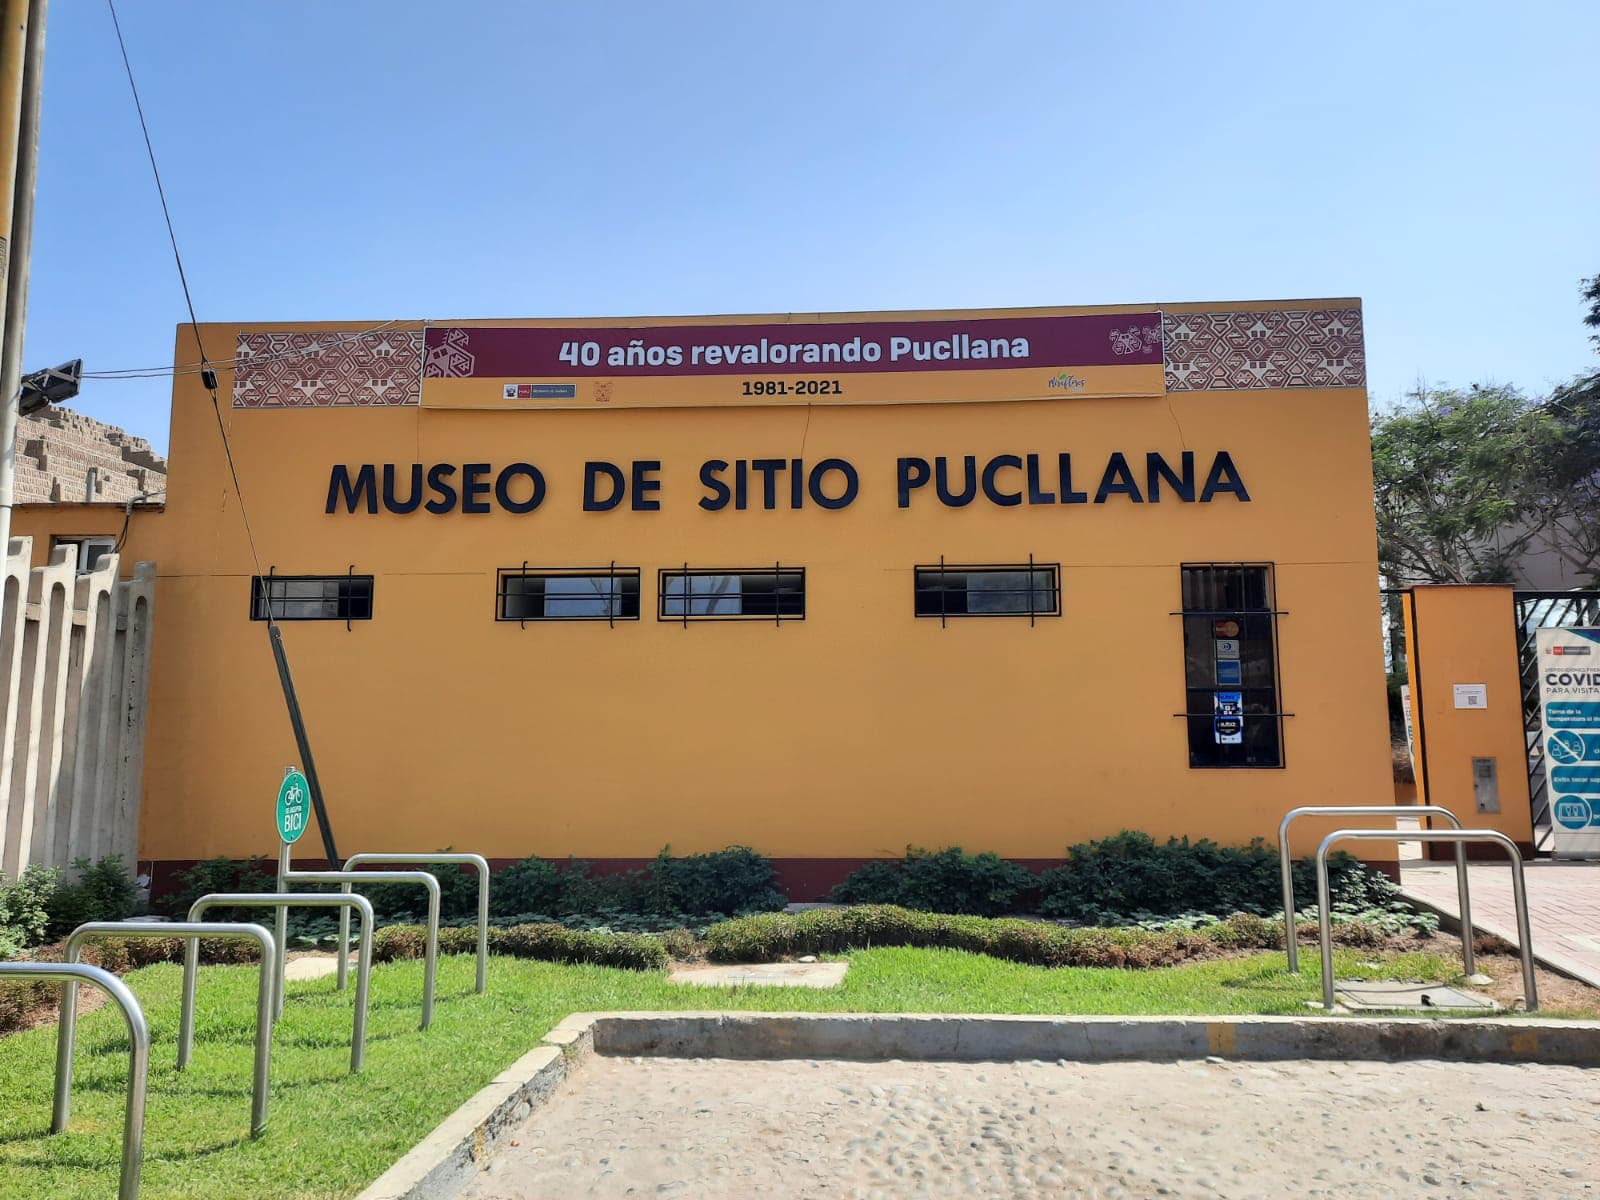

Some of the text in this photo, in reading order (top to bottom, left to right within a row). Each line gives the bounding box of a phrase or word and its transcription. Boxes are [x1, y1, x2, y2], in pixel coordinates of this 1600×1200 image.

[559, 333, 1030, 366] 40 años revalorando Pucllana
[742, 380, 843, 396] 1981-2021
[325, 450, 1252, 515] MUSEO DE SITIO PUCLLANA
[284, 812, 302, 832] BICI
